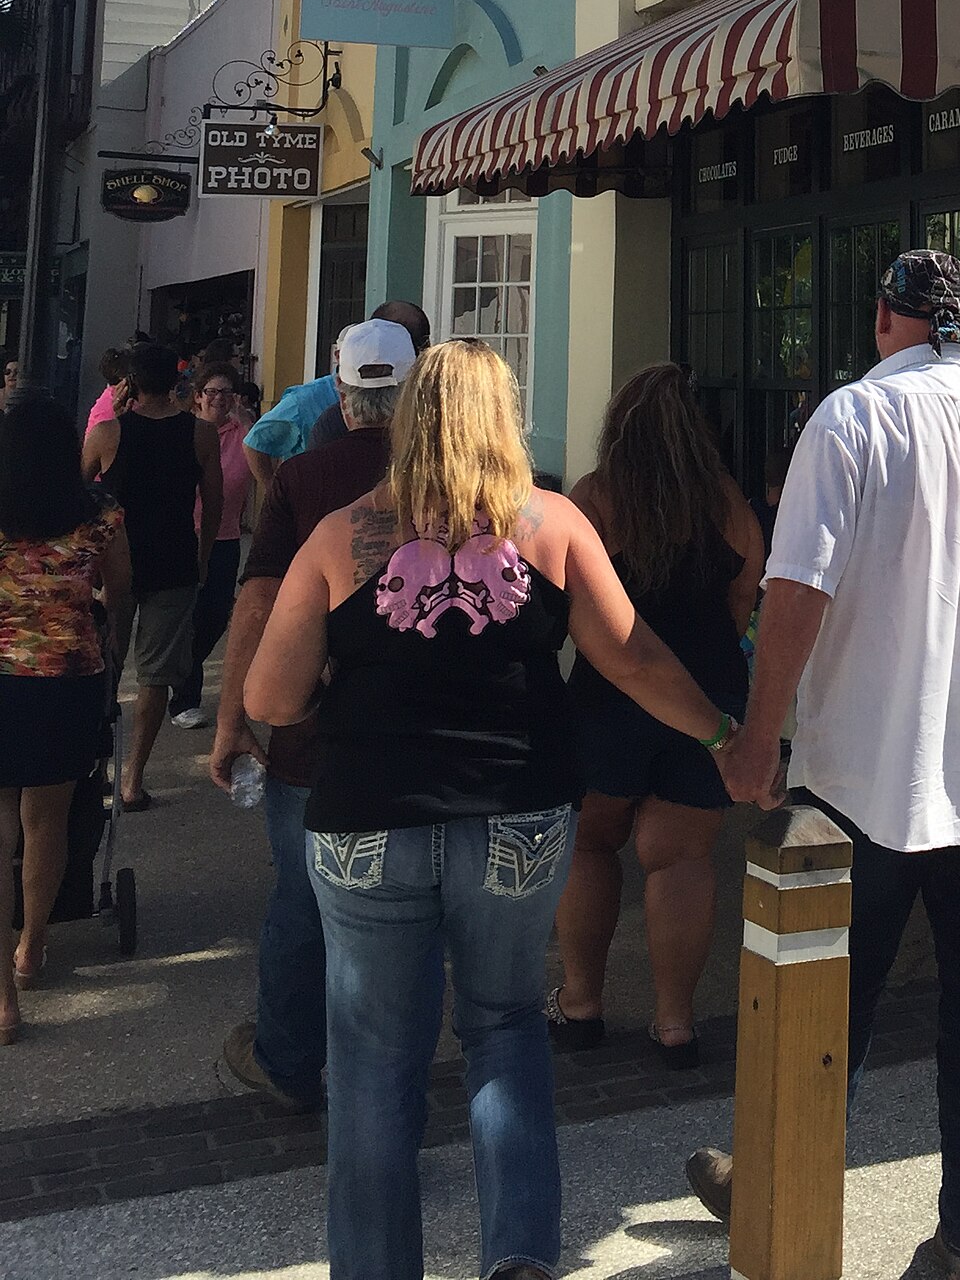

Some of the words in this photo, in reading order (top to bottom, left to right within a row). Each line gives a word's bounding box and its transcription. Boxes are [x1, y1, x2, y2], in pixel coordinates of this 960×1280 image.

[208, 129, 248, 147] OLD
[256, 130, 317, 149] TYME
[842, 124, 894, 152] BEVERAGES
[773, 144, 799, 166] FUDGE
[208, 166, 312, 190] PHOTO
[698, 160, 737, 183] CHOCOLATES
[152, 174, 188, 192] SHOP
